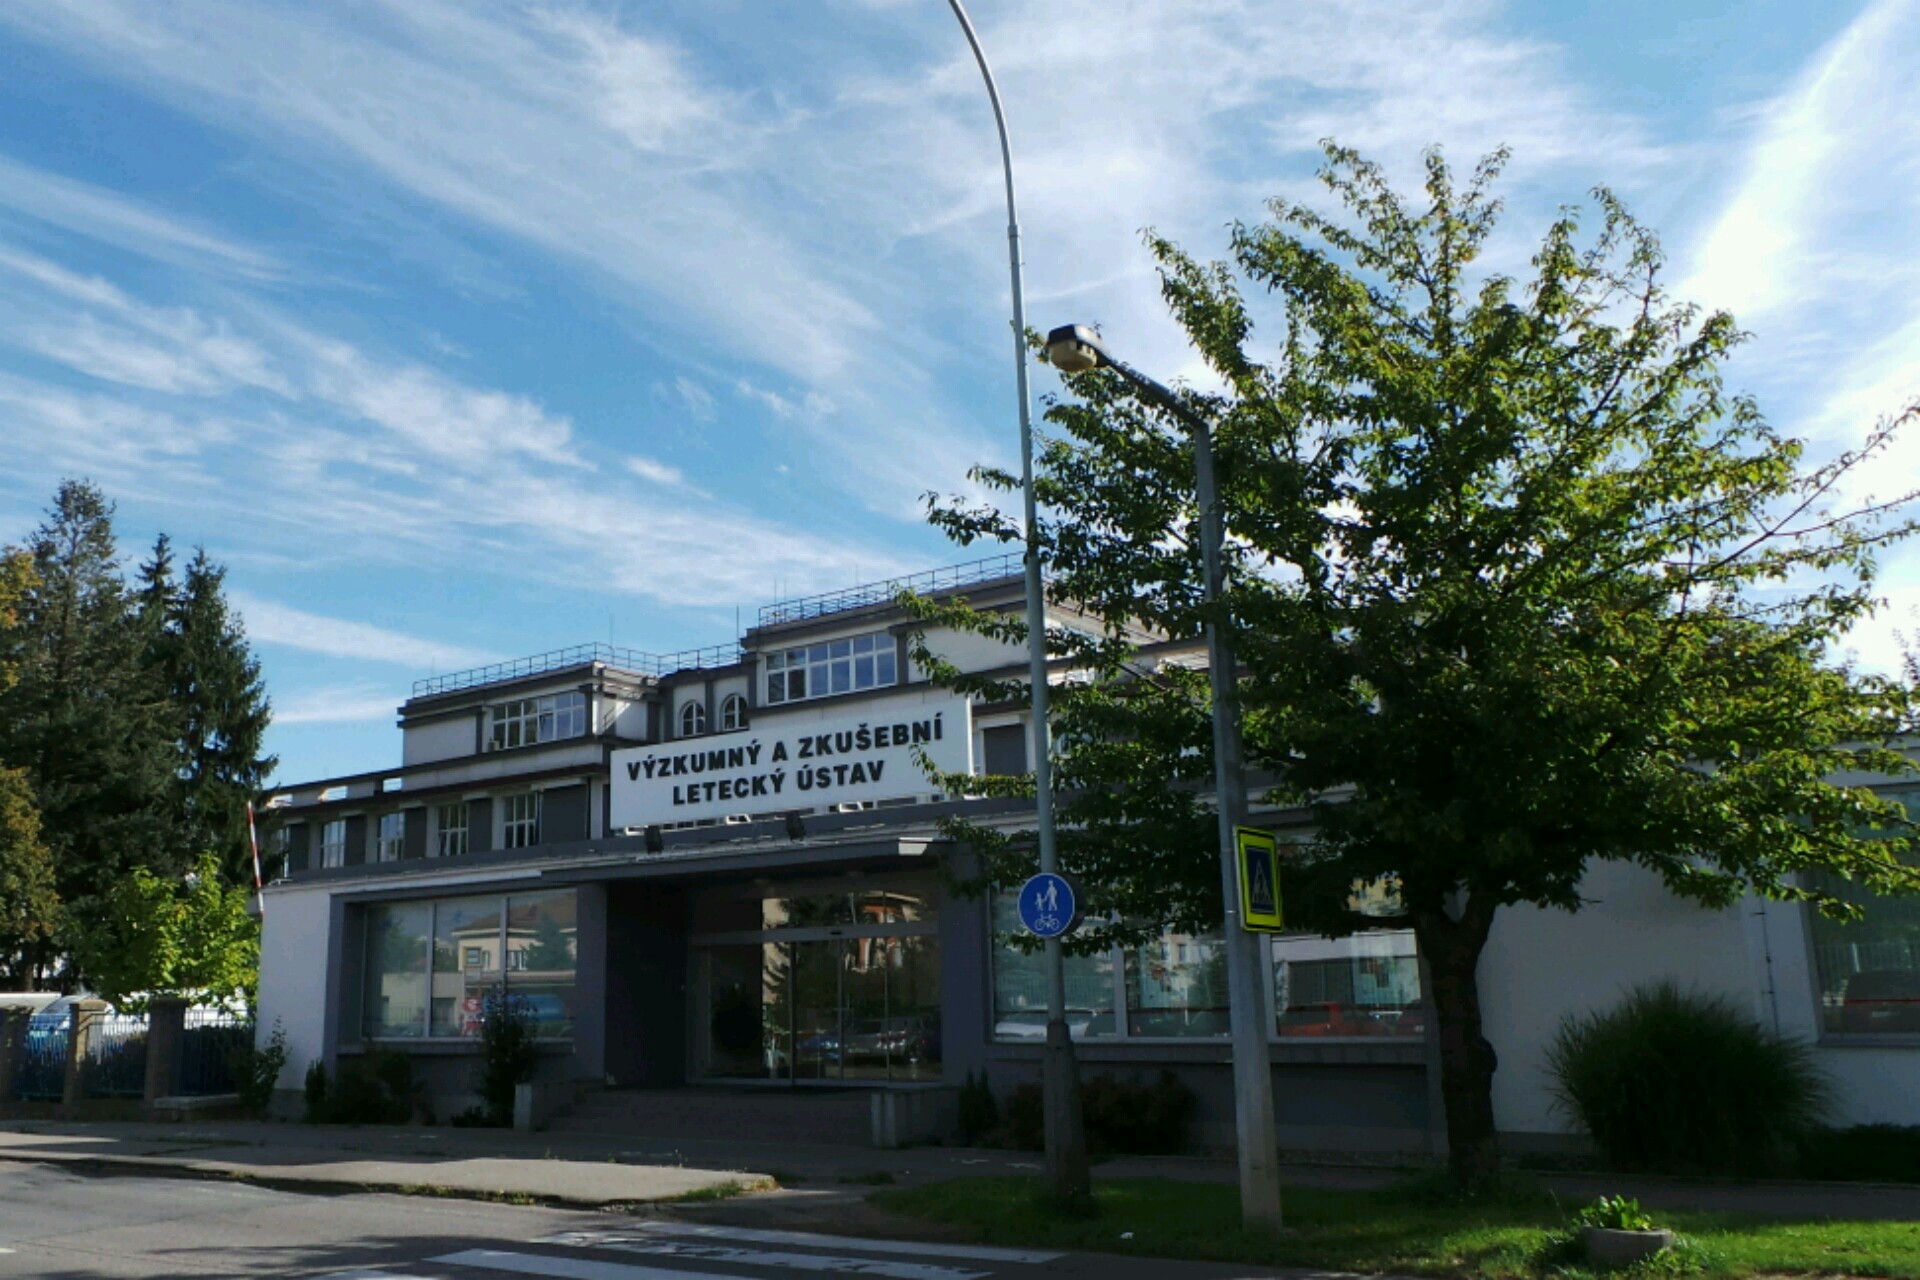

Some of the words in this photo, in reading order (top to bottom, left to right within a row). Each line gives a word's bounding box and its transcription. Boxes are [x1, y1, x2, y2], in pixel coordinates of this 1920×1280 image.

[627, 739, 762, 781] VÝZKUMNÝ
[772, 741, 788, 762] A
[798, 712, 944, 759] ZKUŠEBNÍ
[673, 768, 786, 805] LETECKÝ
[797, 760, 885, 790] ÚSTAV
